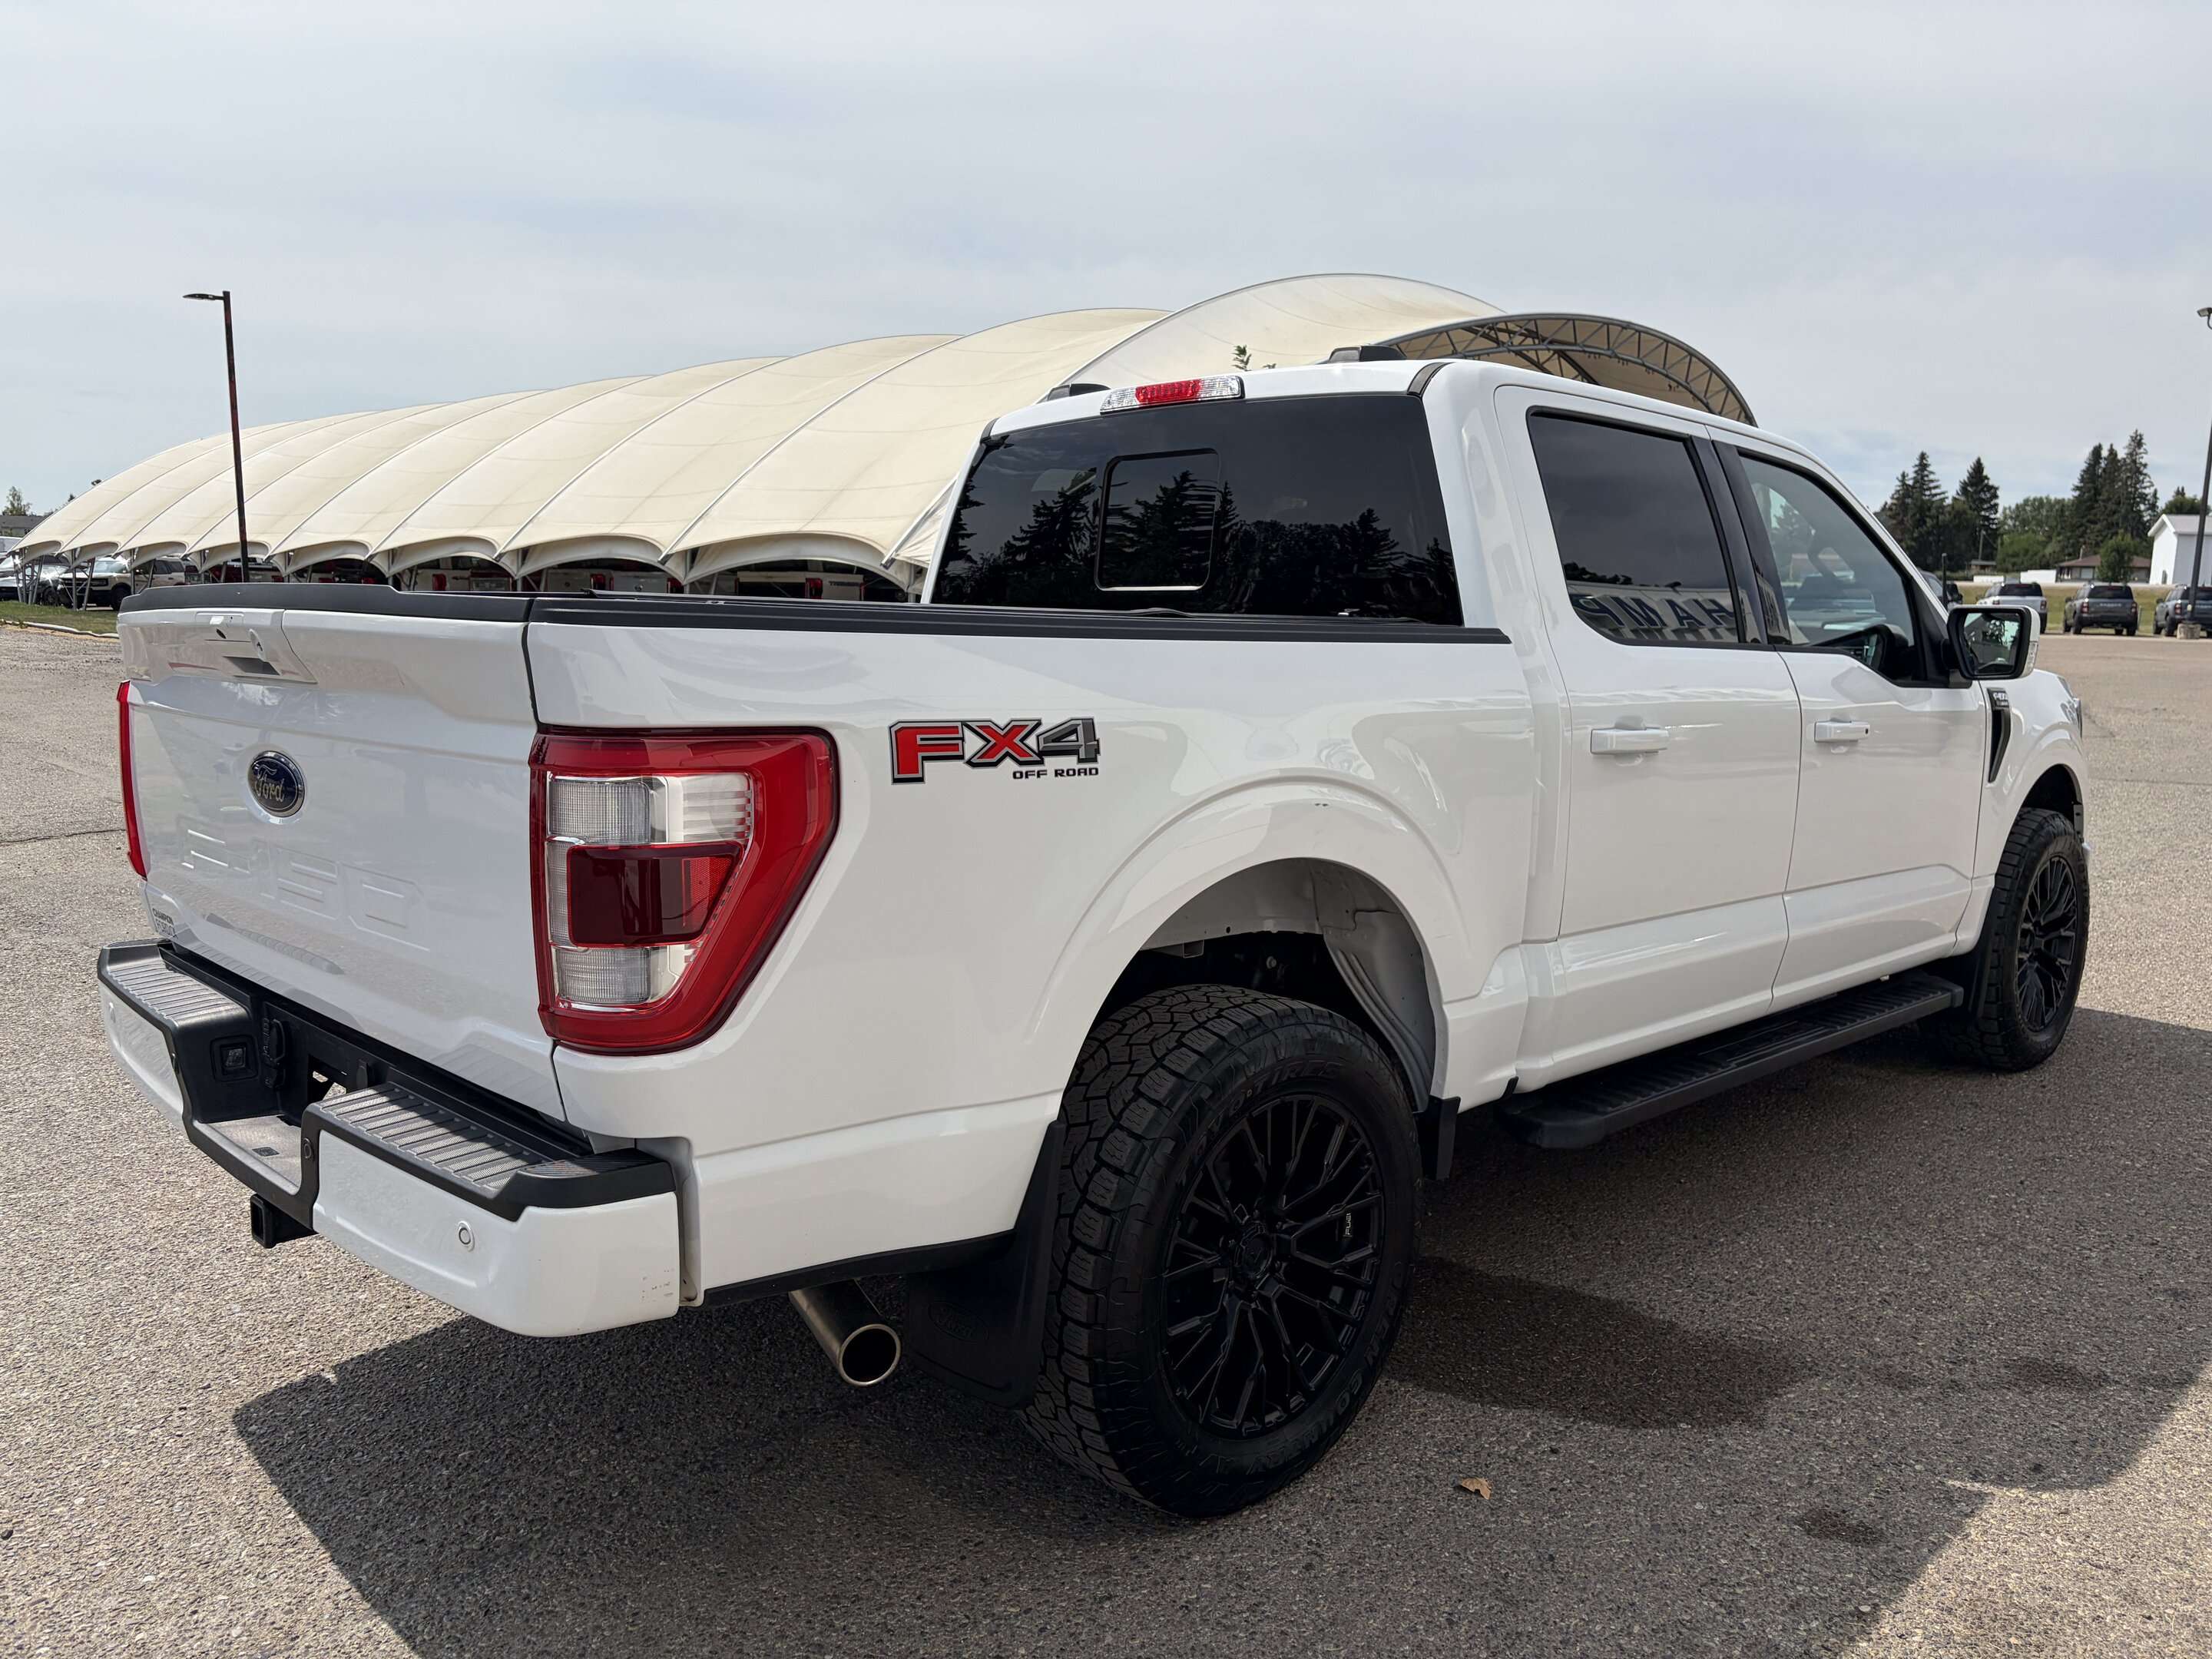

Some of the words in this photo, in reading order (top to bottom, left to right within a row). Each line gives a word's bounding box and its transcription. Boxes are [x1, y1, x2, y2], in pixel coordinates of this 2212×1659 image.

[889, 717, 1101, 785] FX4
[254, 764, 285, 802] Ford
[1012, 770, 1048, 780] OFF
[1054, 767, 1099, 777] ROAD
